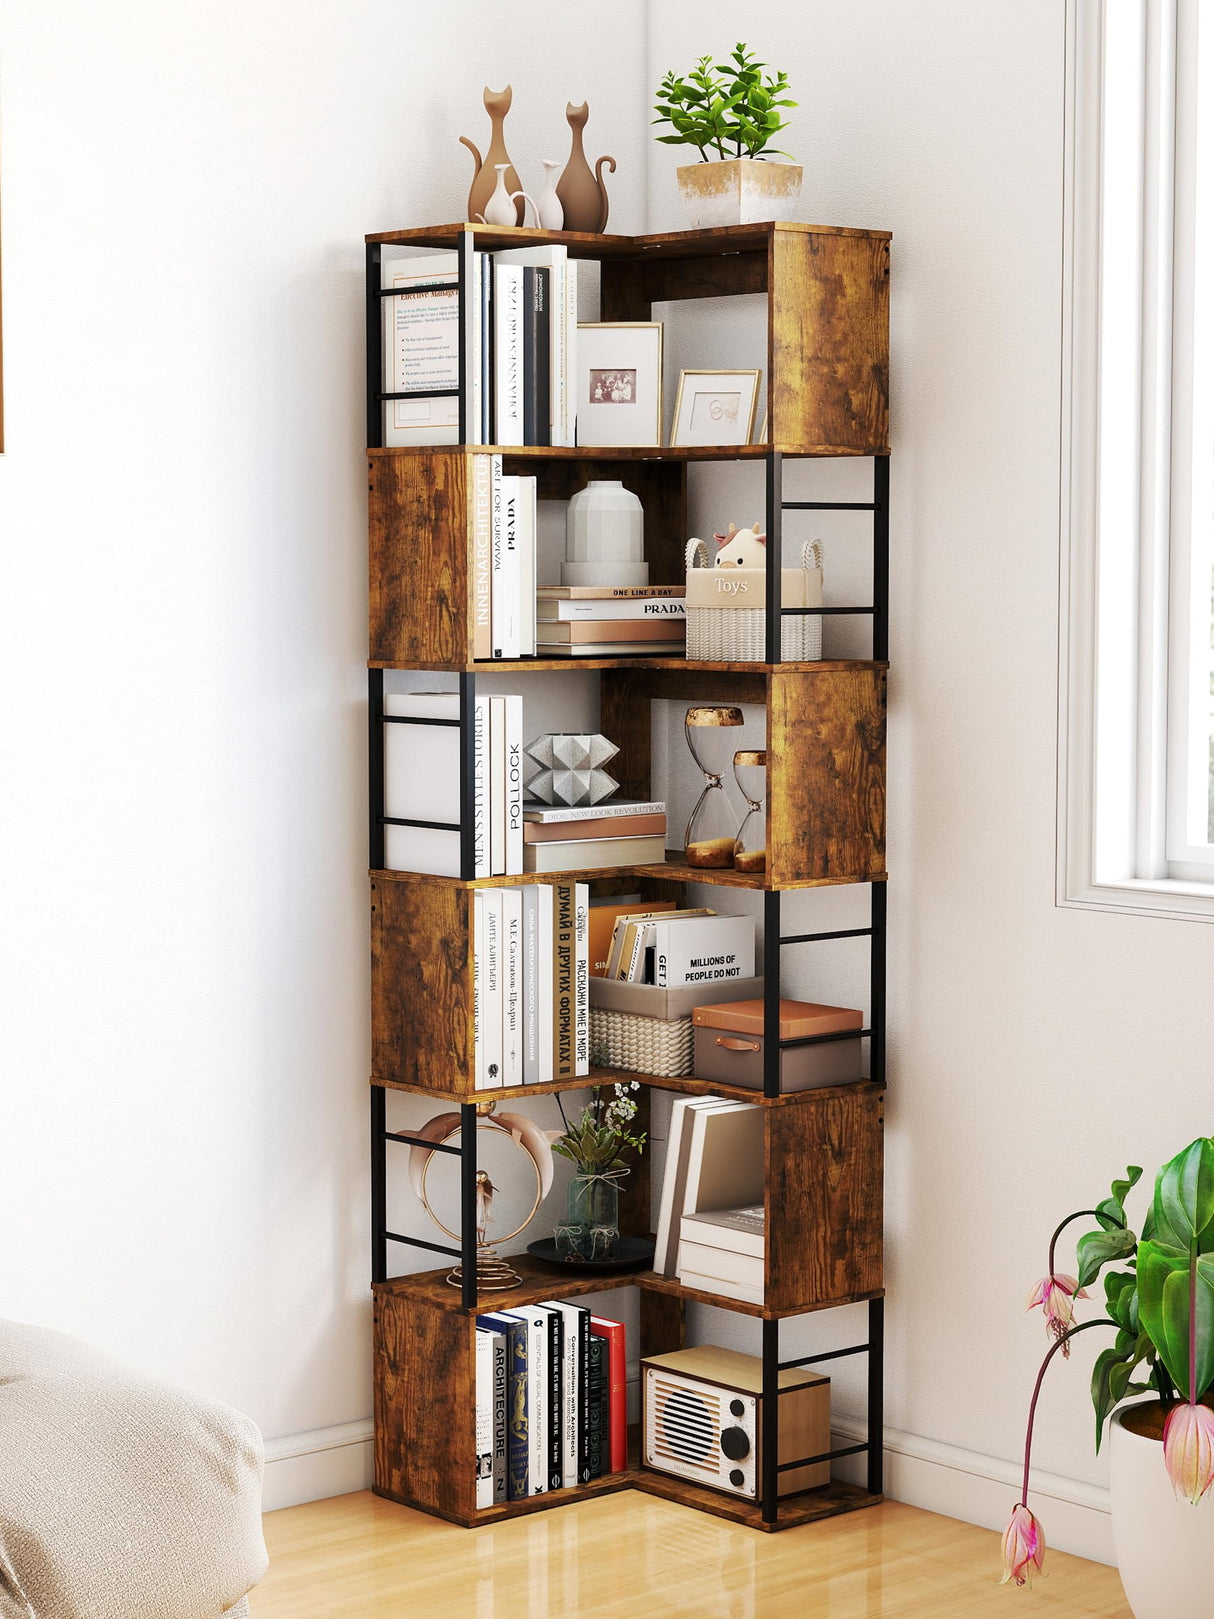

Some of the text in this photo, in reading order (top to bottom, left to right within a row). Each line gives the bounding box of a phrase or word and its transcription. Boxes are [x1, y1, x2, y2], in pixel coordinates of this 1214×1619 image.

[507, 498, 515, 550] PRADA
[714, 577, 748, 597] Toys
[644, 604, 685, 614] PRADA
[474, 706, 484, 866] MENS STYLE STORIES
[509, 743, 520, 830] POLLOCK
[570, 811, 590, 820] NEW
[590, 809, 613, 818] LOOK
[614, 805, 663, 815] REVOLUTION
[557, 885, 573, 929] ДУМАЙ
[488, 912, 497, 942] ДАНТЕ
[558, 945, 571, 993] ДРУГИХ
[659, 955, 667, 980] GET
[685, 967, 741, 982] PEOPLE DO NOT
[690, 955, 736, 968] MILLIONS OF
[577, 959, 586, 1007] РАССКАЖИ
[559, 997, 571, 1063] ФОРМАТАХ
[577, 1009, 586, 1028] МНЕ
[577, 1037, 586, 1062] МОРЕ
[496, 1347, 505, 1458] ARCHITECTURE
